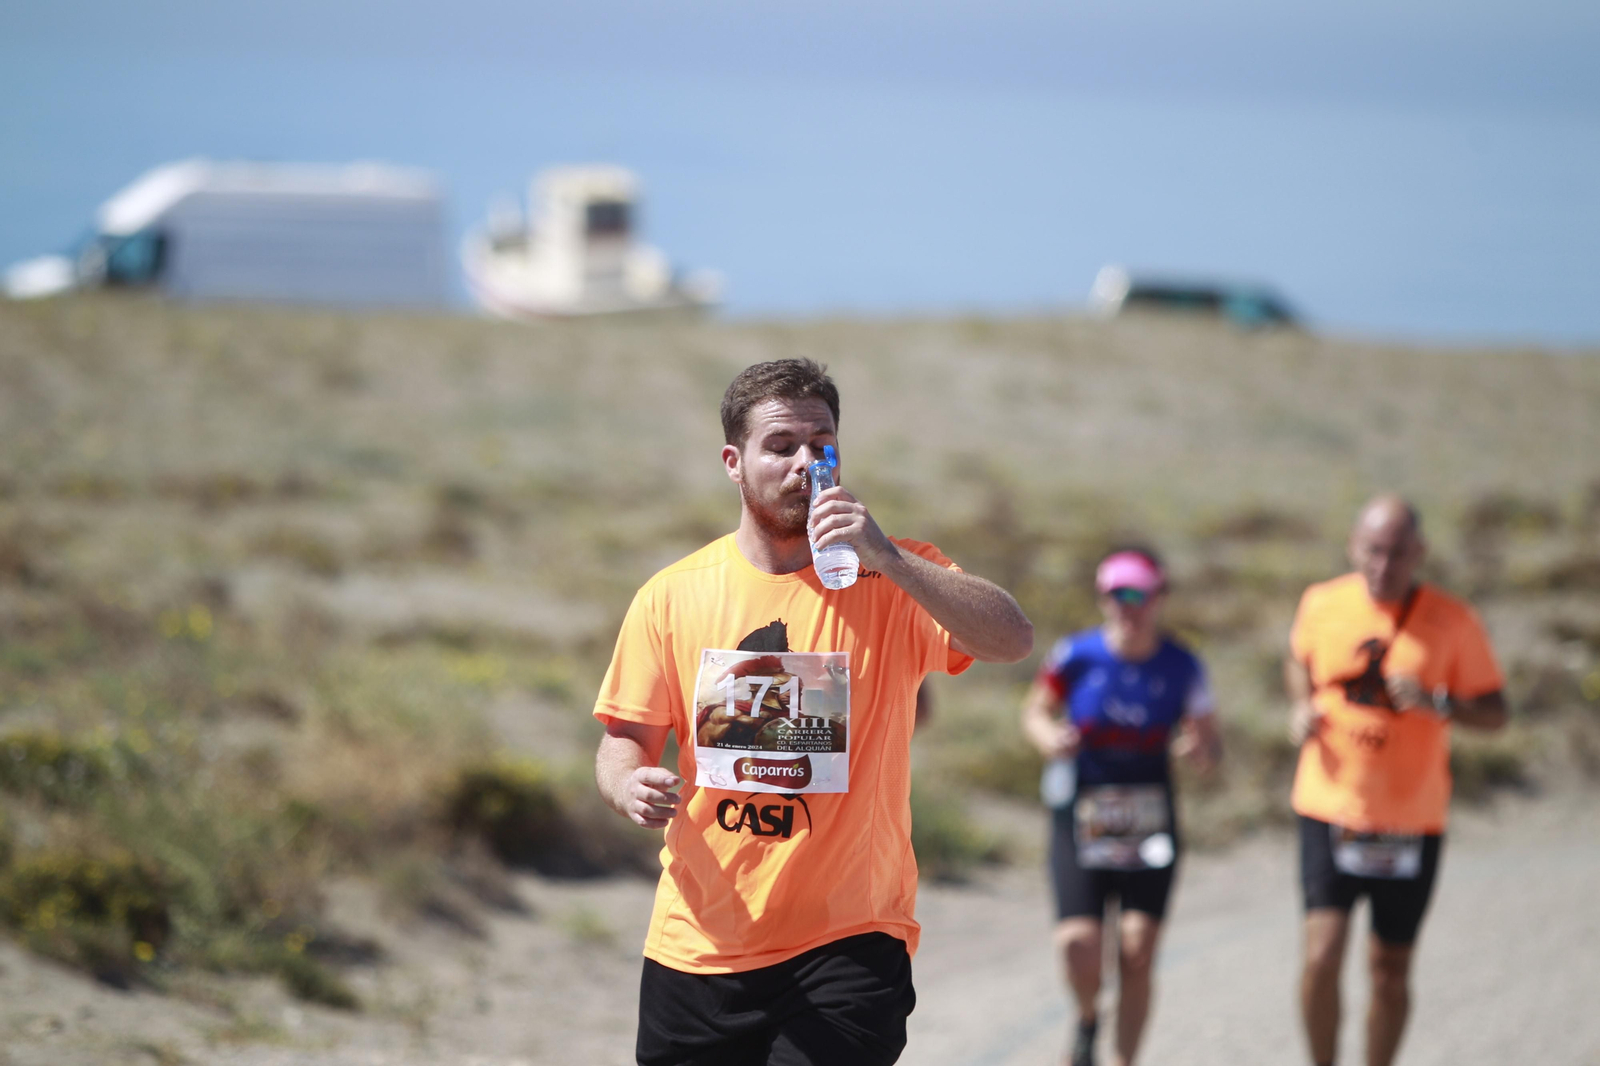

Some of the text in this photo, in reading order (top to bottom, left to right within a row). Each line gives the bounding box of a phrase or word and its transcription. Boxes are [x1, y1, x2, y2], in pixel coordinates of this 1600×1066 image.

[717, 673, 799, 718] 171
[777, 717, 832, 728] XIII
[716, 799, 794, 838] CASI
